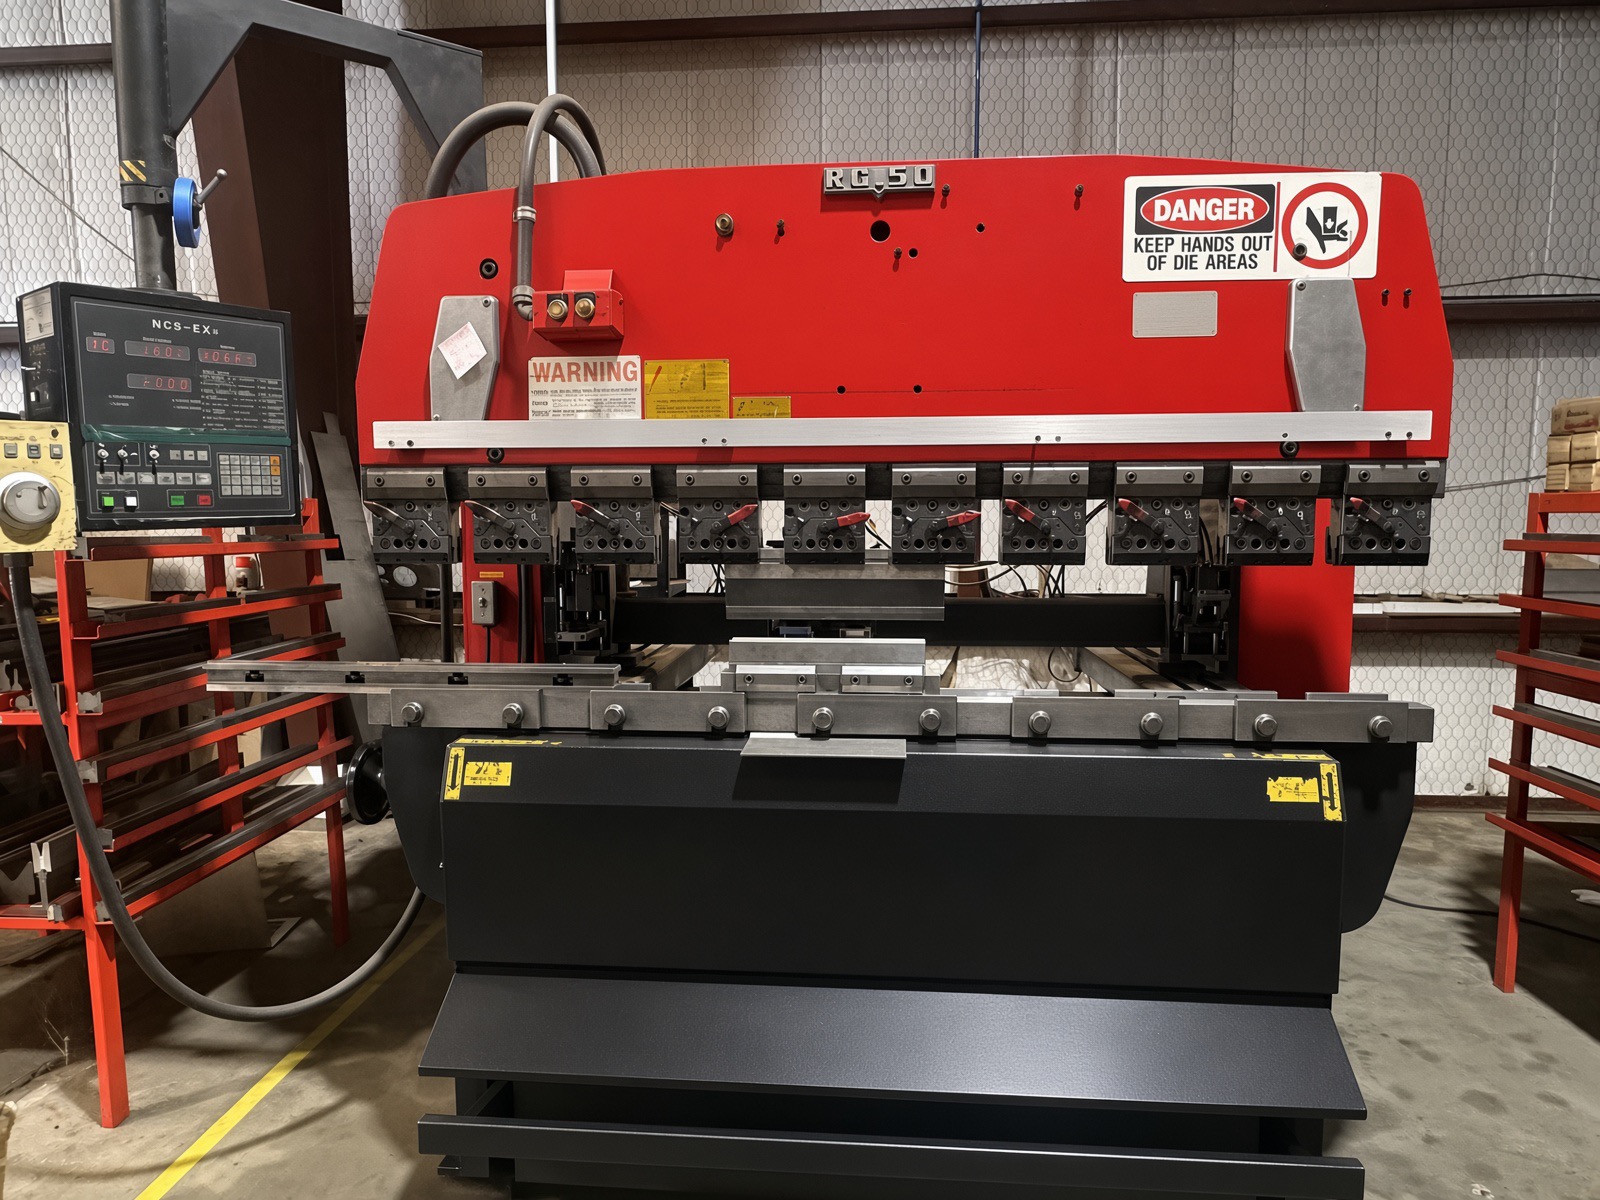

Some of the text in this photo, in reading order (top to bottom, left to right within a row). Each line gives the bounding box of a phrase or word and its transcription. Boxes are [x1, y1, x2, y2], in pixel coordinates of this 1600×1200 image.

[825, 166, 933, 189] RG 50
[1153, 197, 1255, 222] DANGER
[1134, 235, 1273, 253] KEEP HANDS OUT
[1147, 253, 1258, 271] OF DIE AREAS
[533, 360, 638, 383] WARNING
